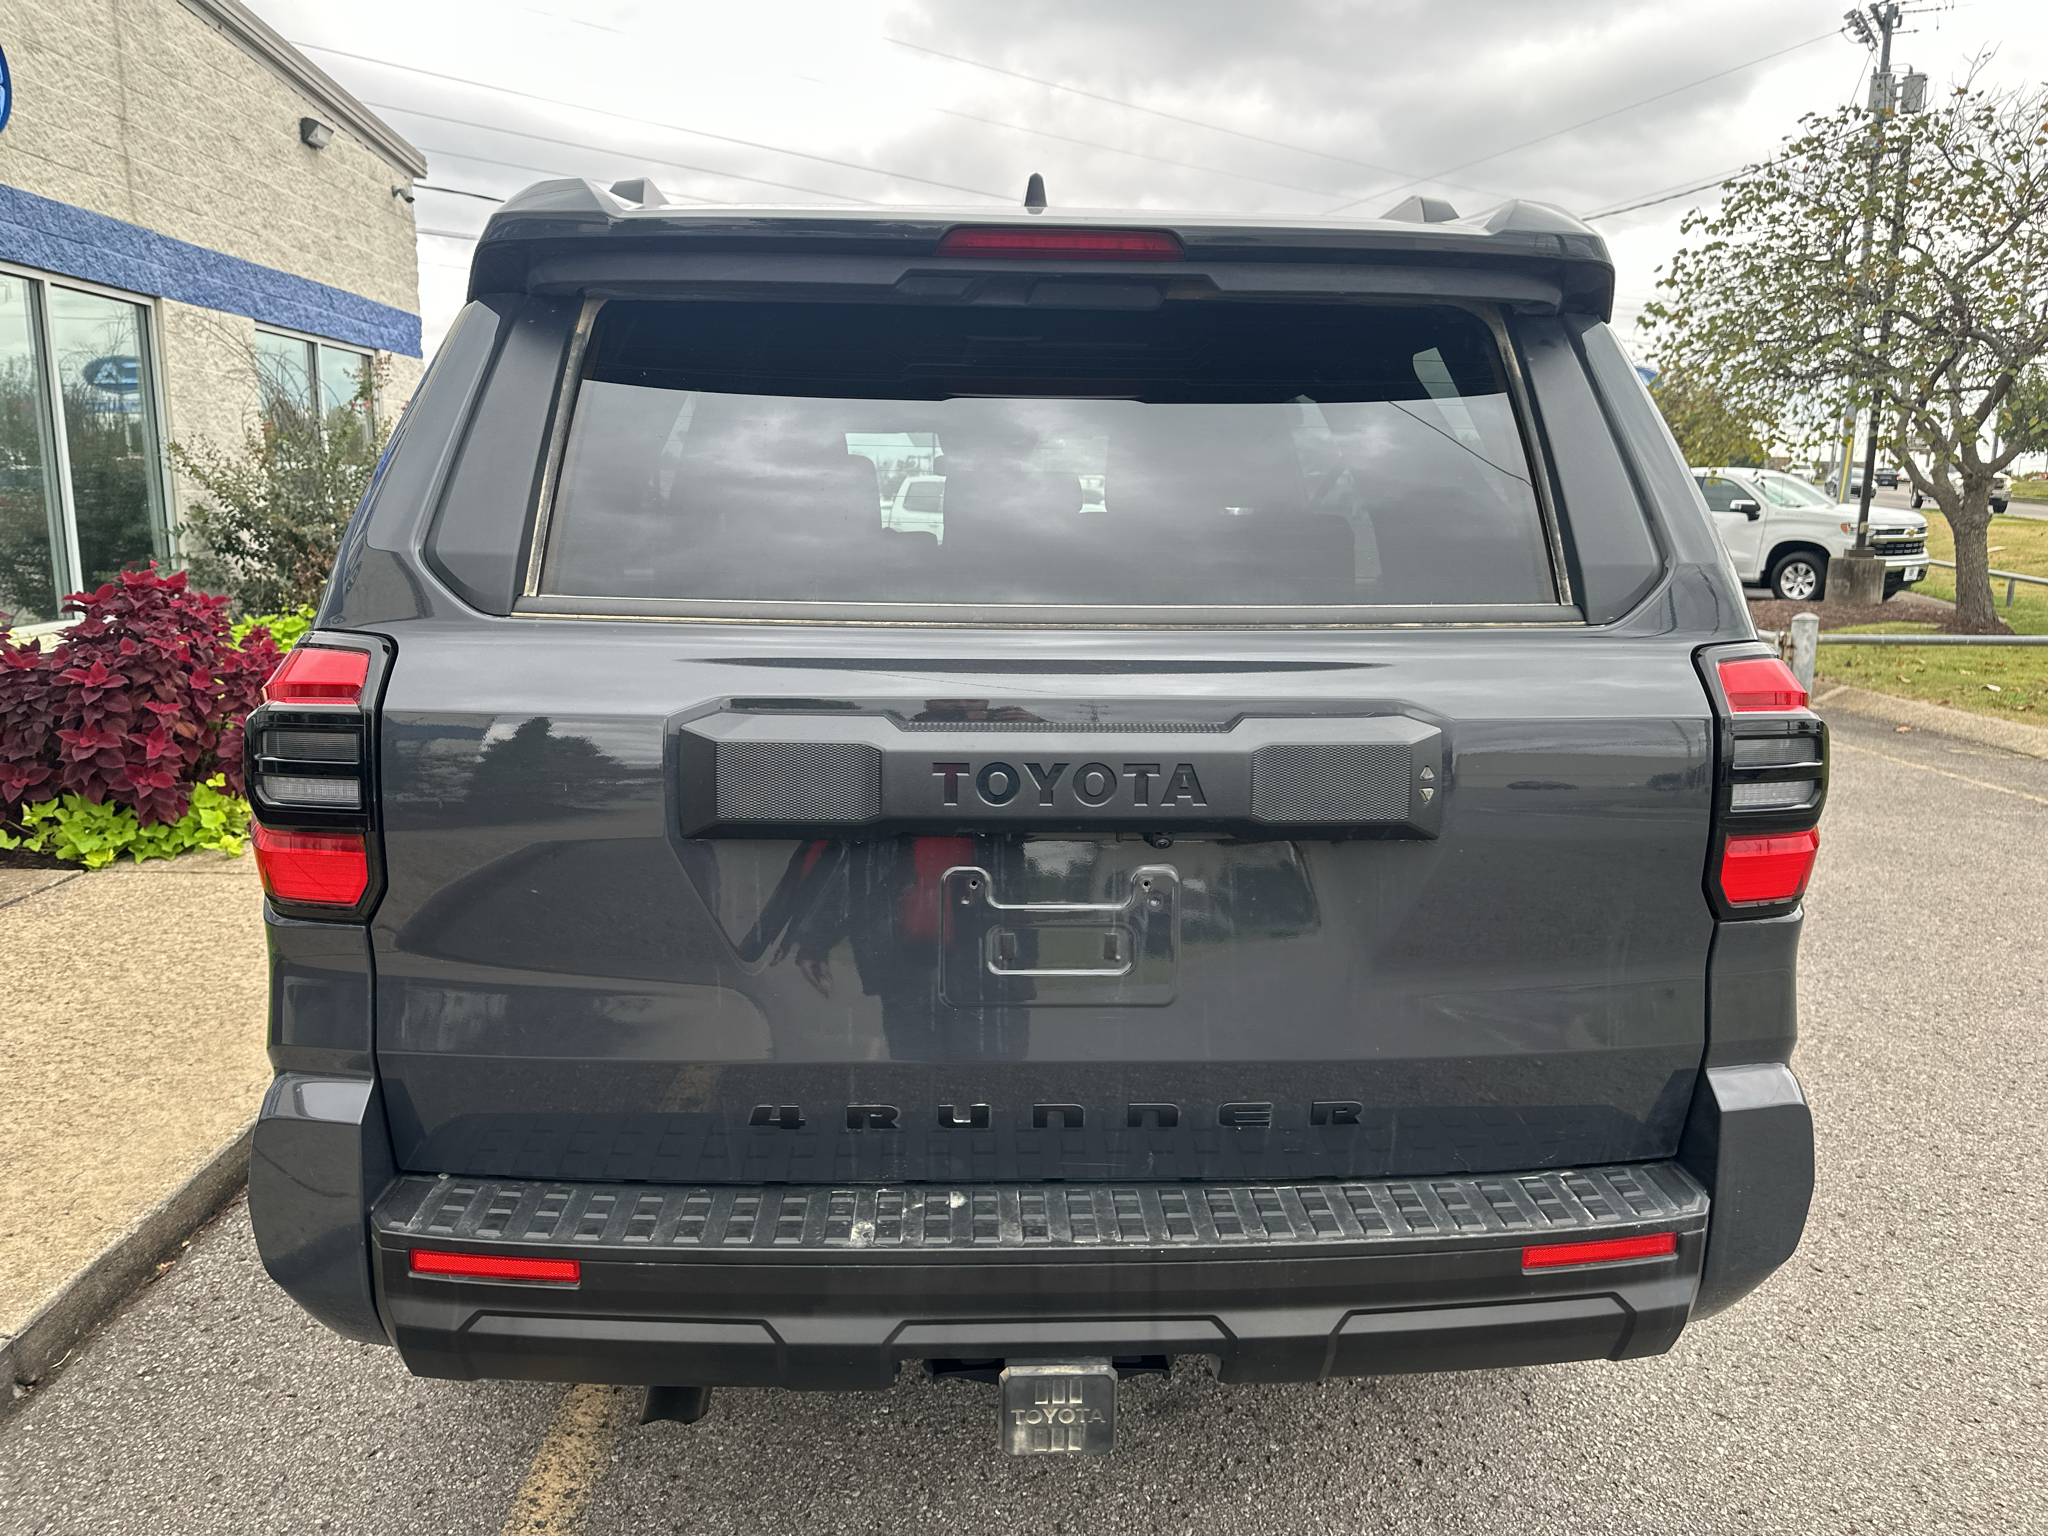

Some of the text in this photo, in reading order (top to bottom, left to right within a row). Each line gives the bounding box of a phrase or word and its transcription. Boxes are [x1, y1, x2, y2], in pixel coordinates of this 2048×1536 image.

[932, 762, 1208, 808] TOYOTA
[749, 1101, 1363, 1129] 4RUNNER
[1010, 1408, 1106, 1425] TOYOTA
